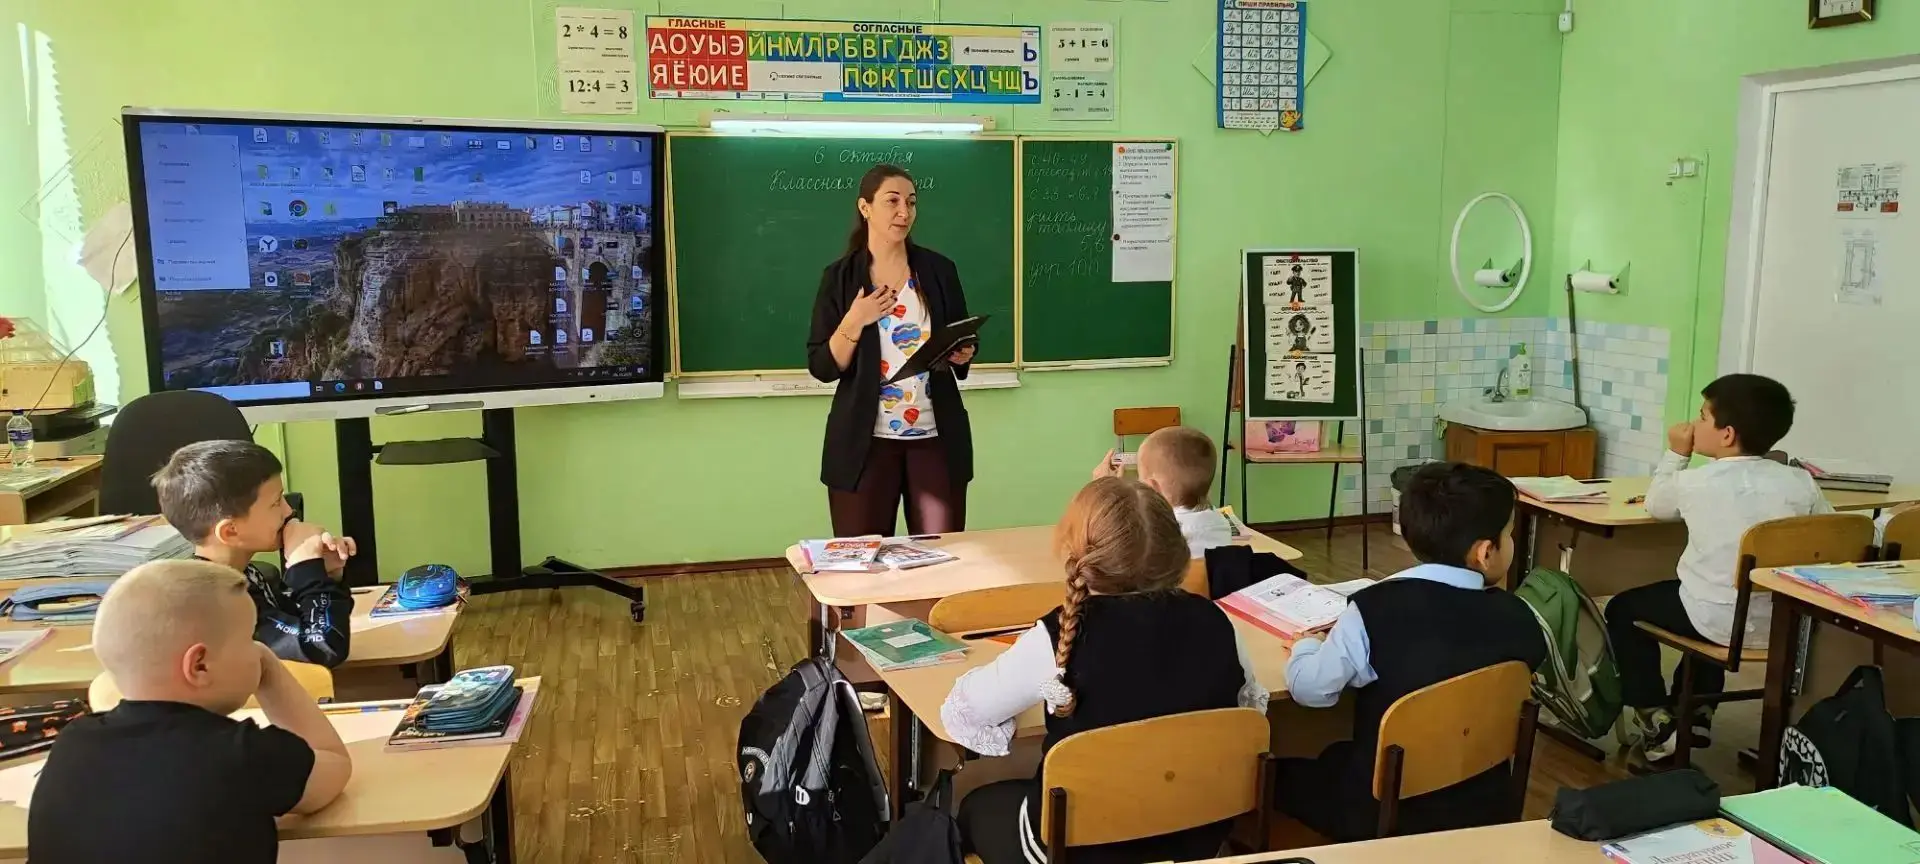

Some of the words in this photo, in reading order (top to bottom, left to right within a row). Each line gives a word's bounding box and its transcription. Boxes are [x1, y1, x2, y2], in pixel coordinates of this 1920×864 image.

[668, 18, 726, 29] ГЛАСНЫЕ
[853, 23, 922, 34] СОГЛАСНЫЕ
[562, 24, 571, 38] 2
[590, 25, 599, 38] 4
[618, 26, 628, 39] 8
[1081, 39, 1086, 48] 1
[1101, 39, 1109, 48] 6
[569, 79, 600, 92] 12:4
[620, 80, 629, 93] 3
[814, 146, 824, 164] 6
[769, 169, 854, 192] Классная
